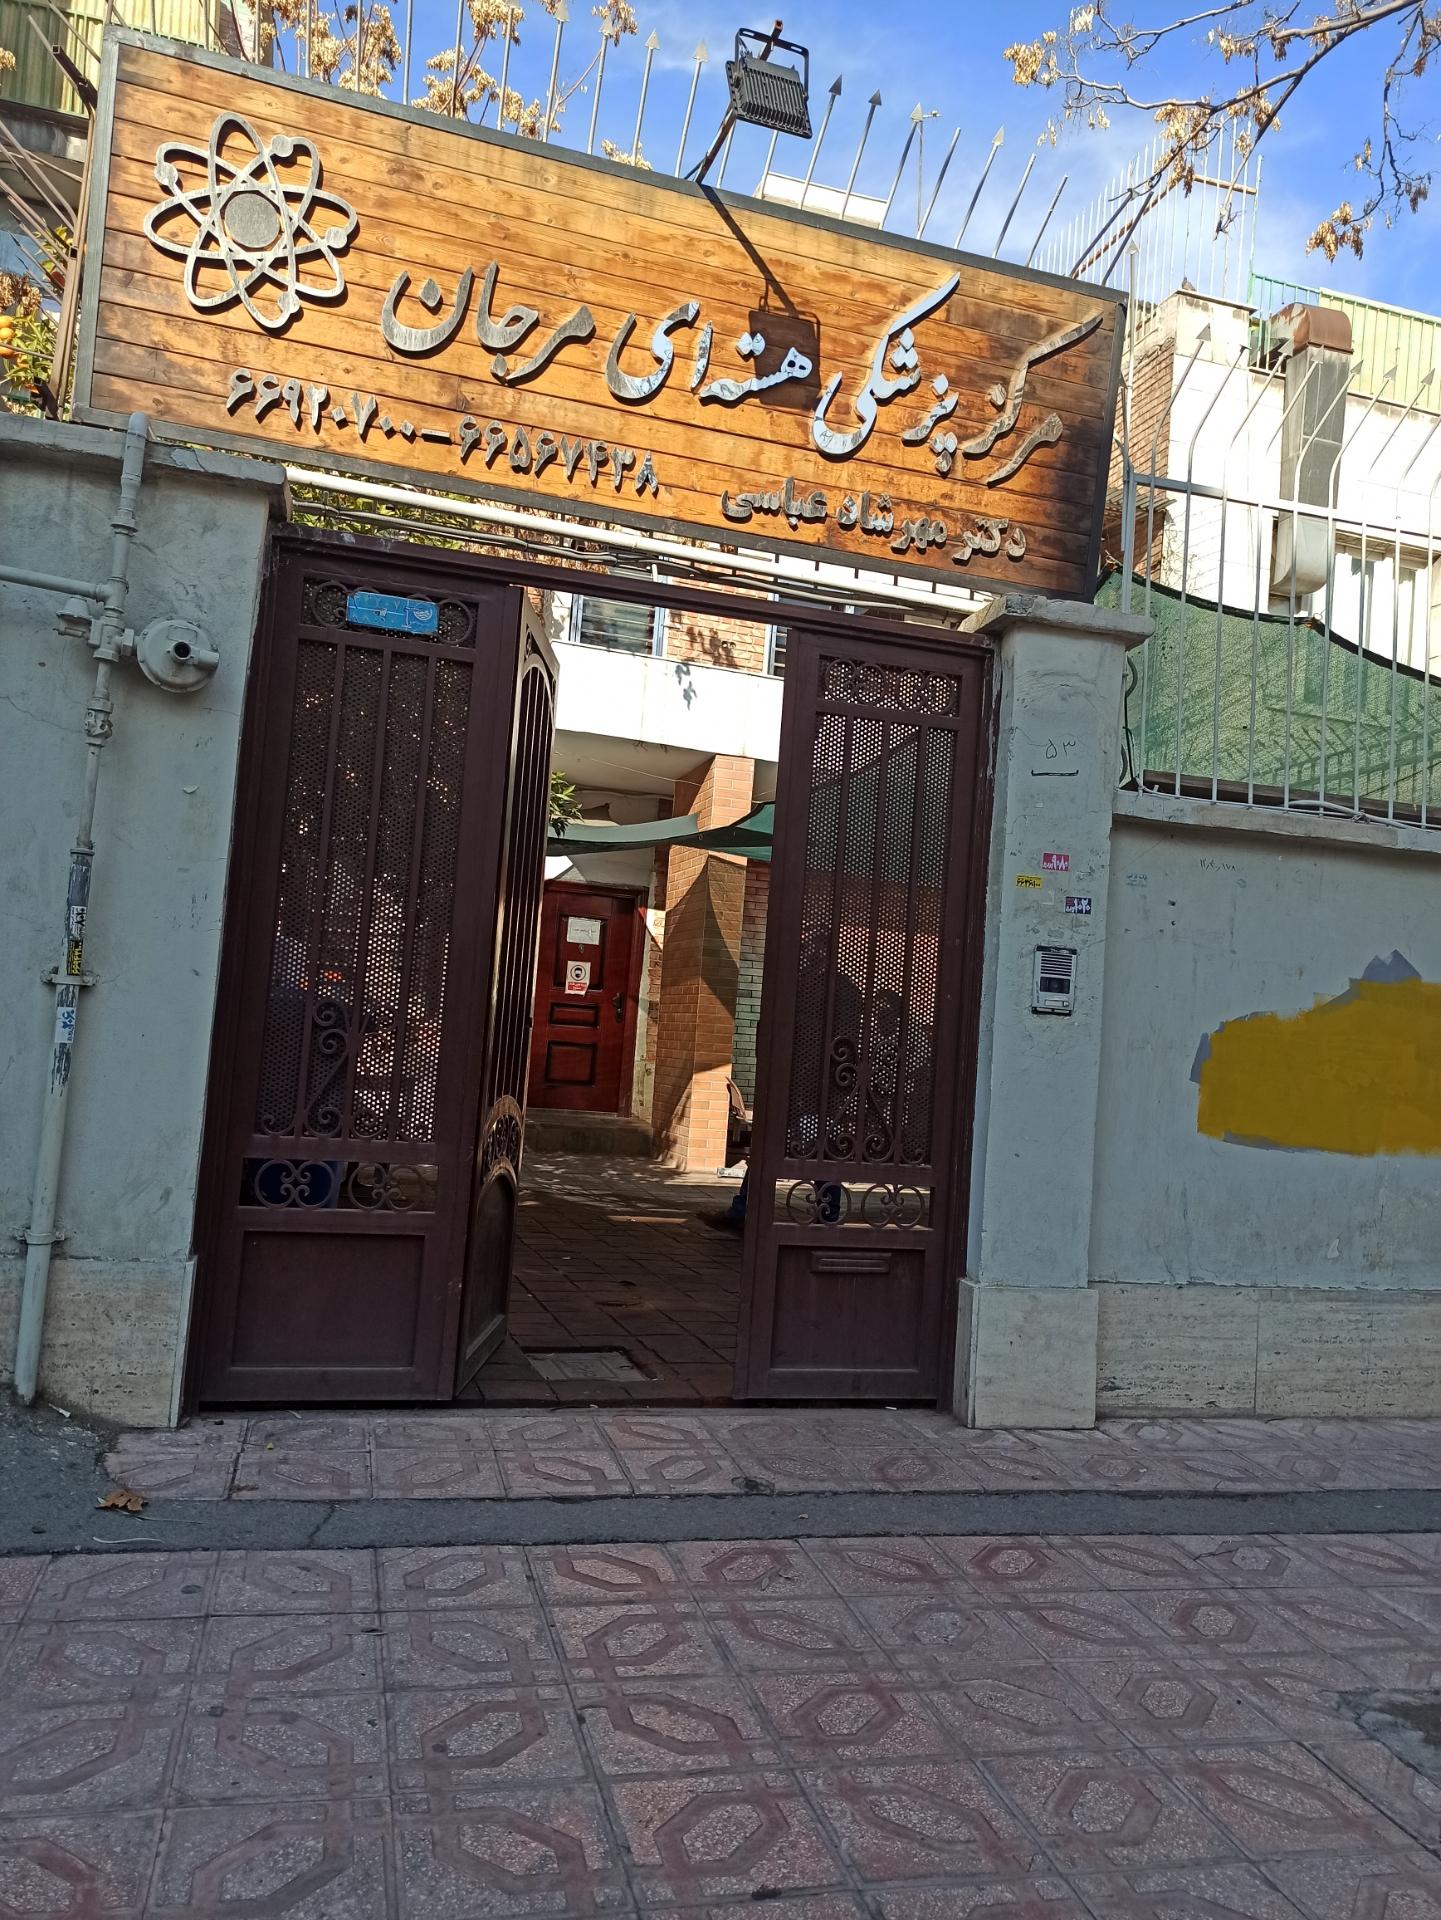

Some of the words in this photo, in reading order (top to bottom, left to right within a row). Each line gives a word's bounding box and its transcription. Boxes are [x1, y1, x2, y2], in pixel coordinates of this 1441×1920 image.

[381, 260, 595, 383] مرجان
[812, 272, 961, 474] پزشکی
[962, 311, 1103, 486] مرکز
[720, 476, 829, 527] عباسی
[835, 490, 948, 550] مهرشاد
[951, 517, 1027, 561] دکتر
[1045, 738, 1076, 760] ۵۳
